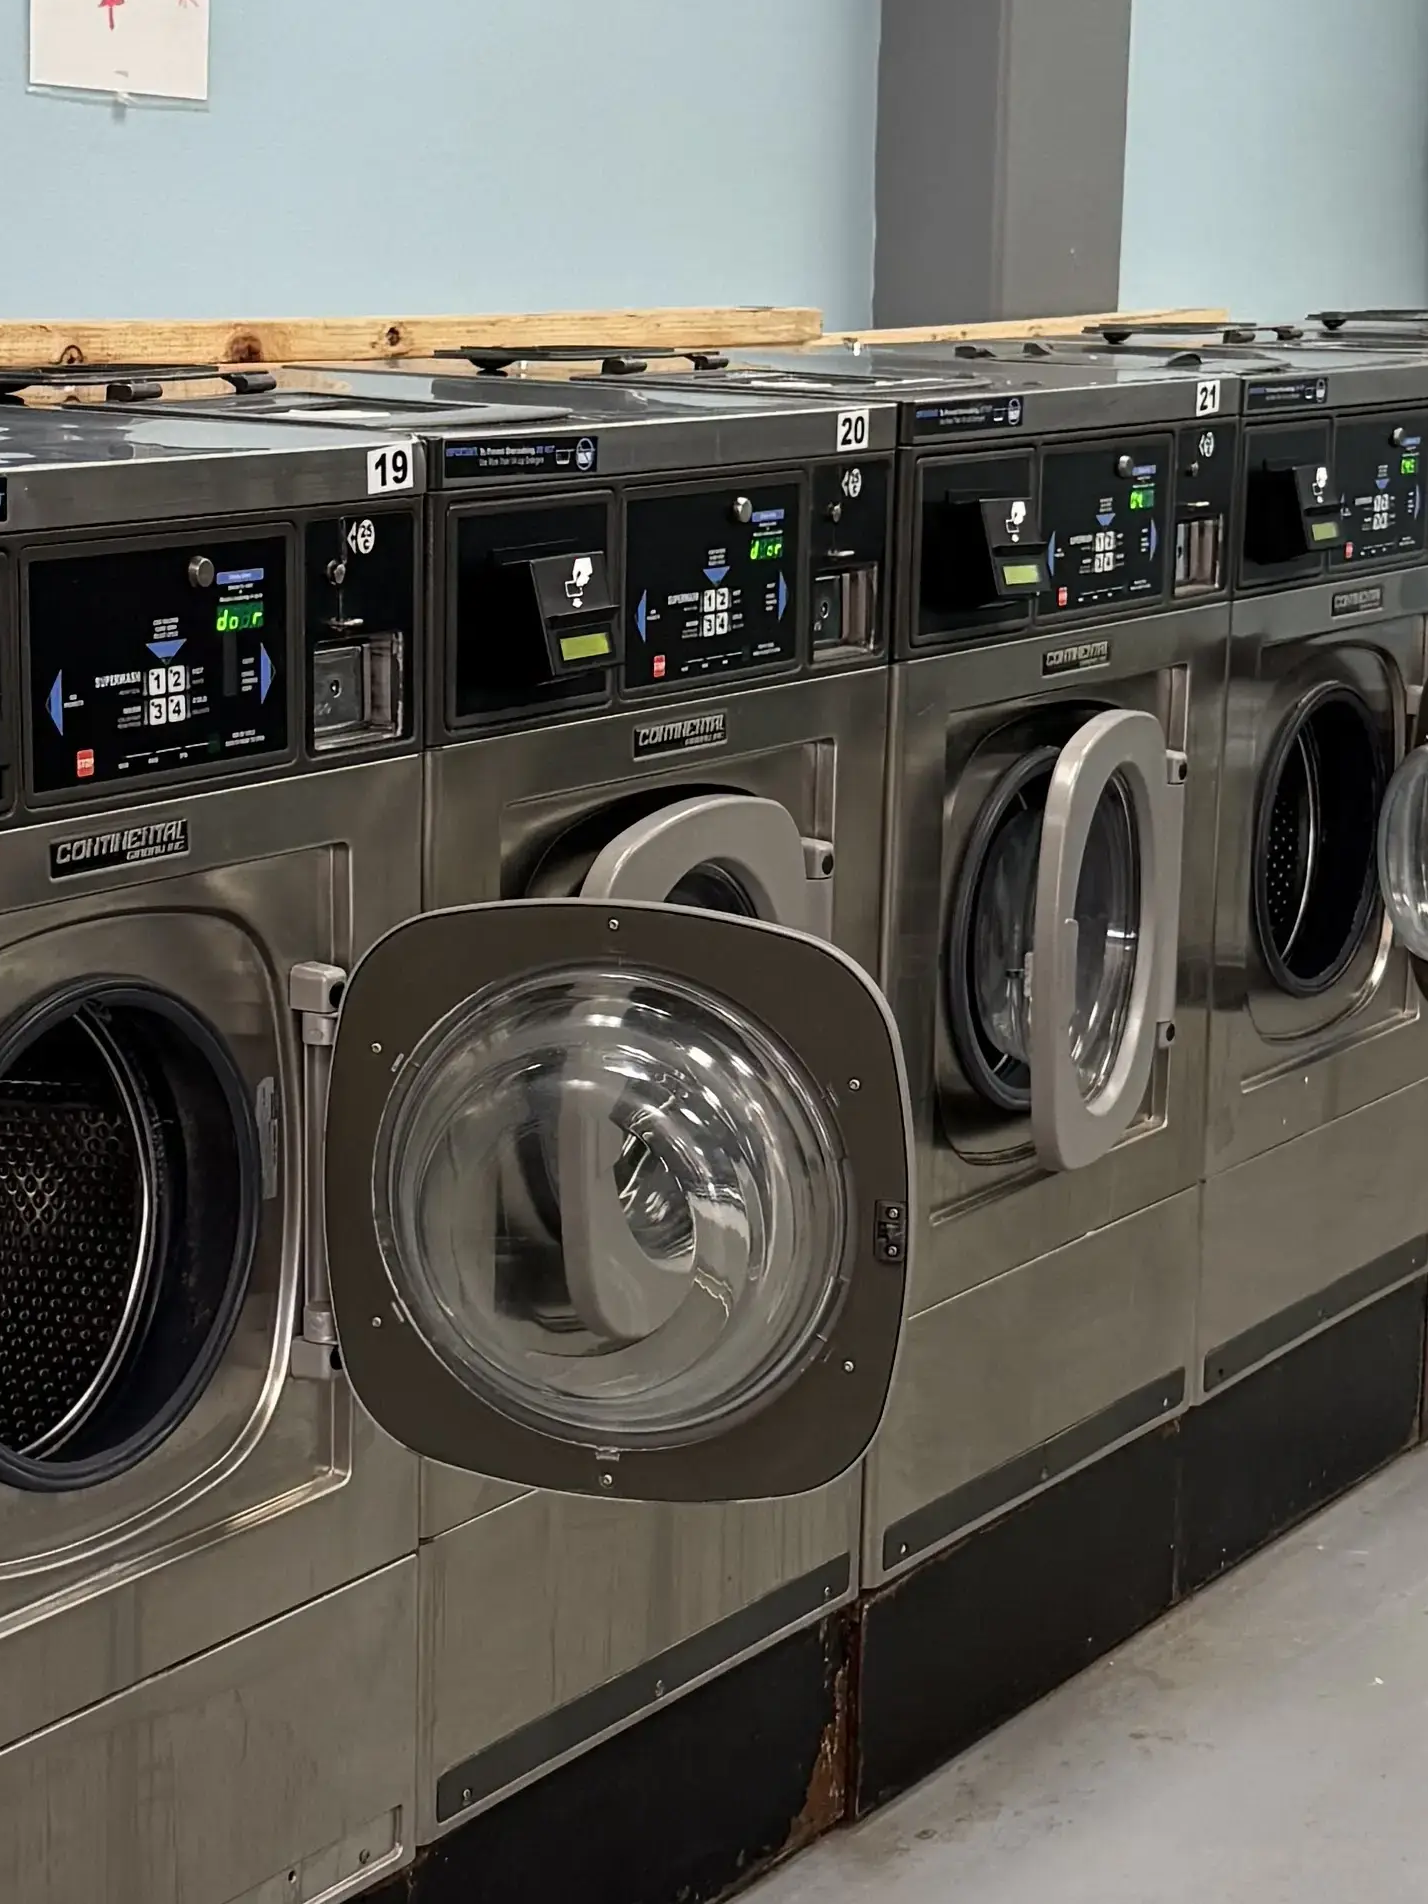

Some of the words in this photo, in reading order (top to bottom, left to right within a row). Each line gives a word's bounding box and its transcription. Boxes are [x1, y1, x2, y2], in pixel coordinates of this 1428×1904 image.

[1200, 384, 1215, 411] 21
[841, 416, 864, 445] 20
[375, 450, 408, 487] 19
[750, 540, 782, 560] dor
[217, 609, 263, 631] dor
[154, 674, 160, 689] 1
[173, 671, 181, 687] 2
[154, 703, 162, 719] 3
[173, 700, 181, 716] 4
[56, 820, 185, 864] CONTINENTAL
